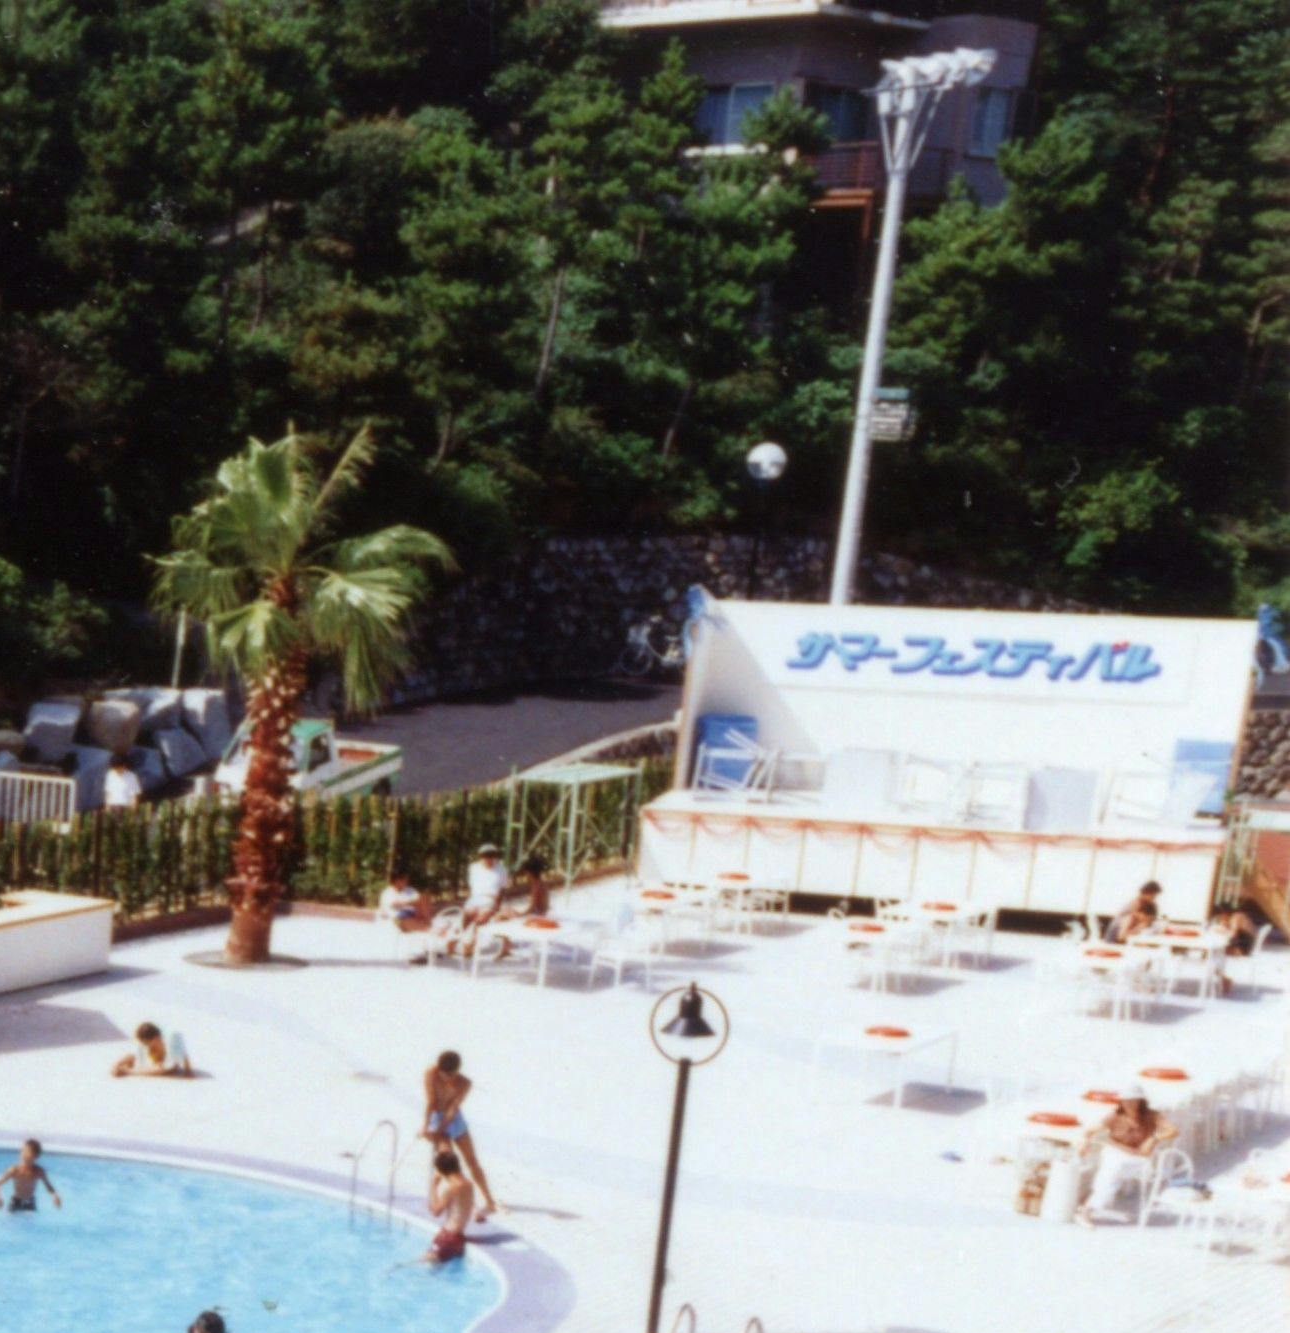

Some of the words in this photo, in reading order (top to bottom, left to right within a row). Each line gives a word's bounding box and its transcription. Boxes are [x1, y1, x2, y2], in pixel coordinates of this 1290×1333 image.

[786, 631, 1162, 683] サマーフェスティバル
